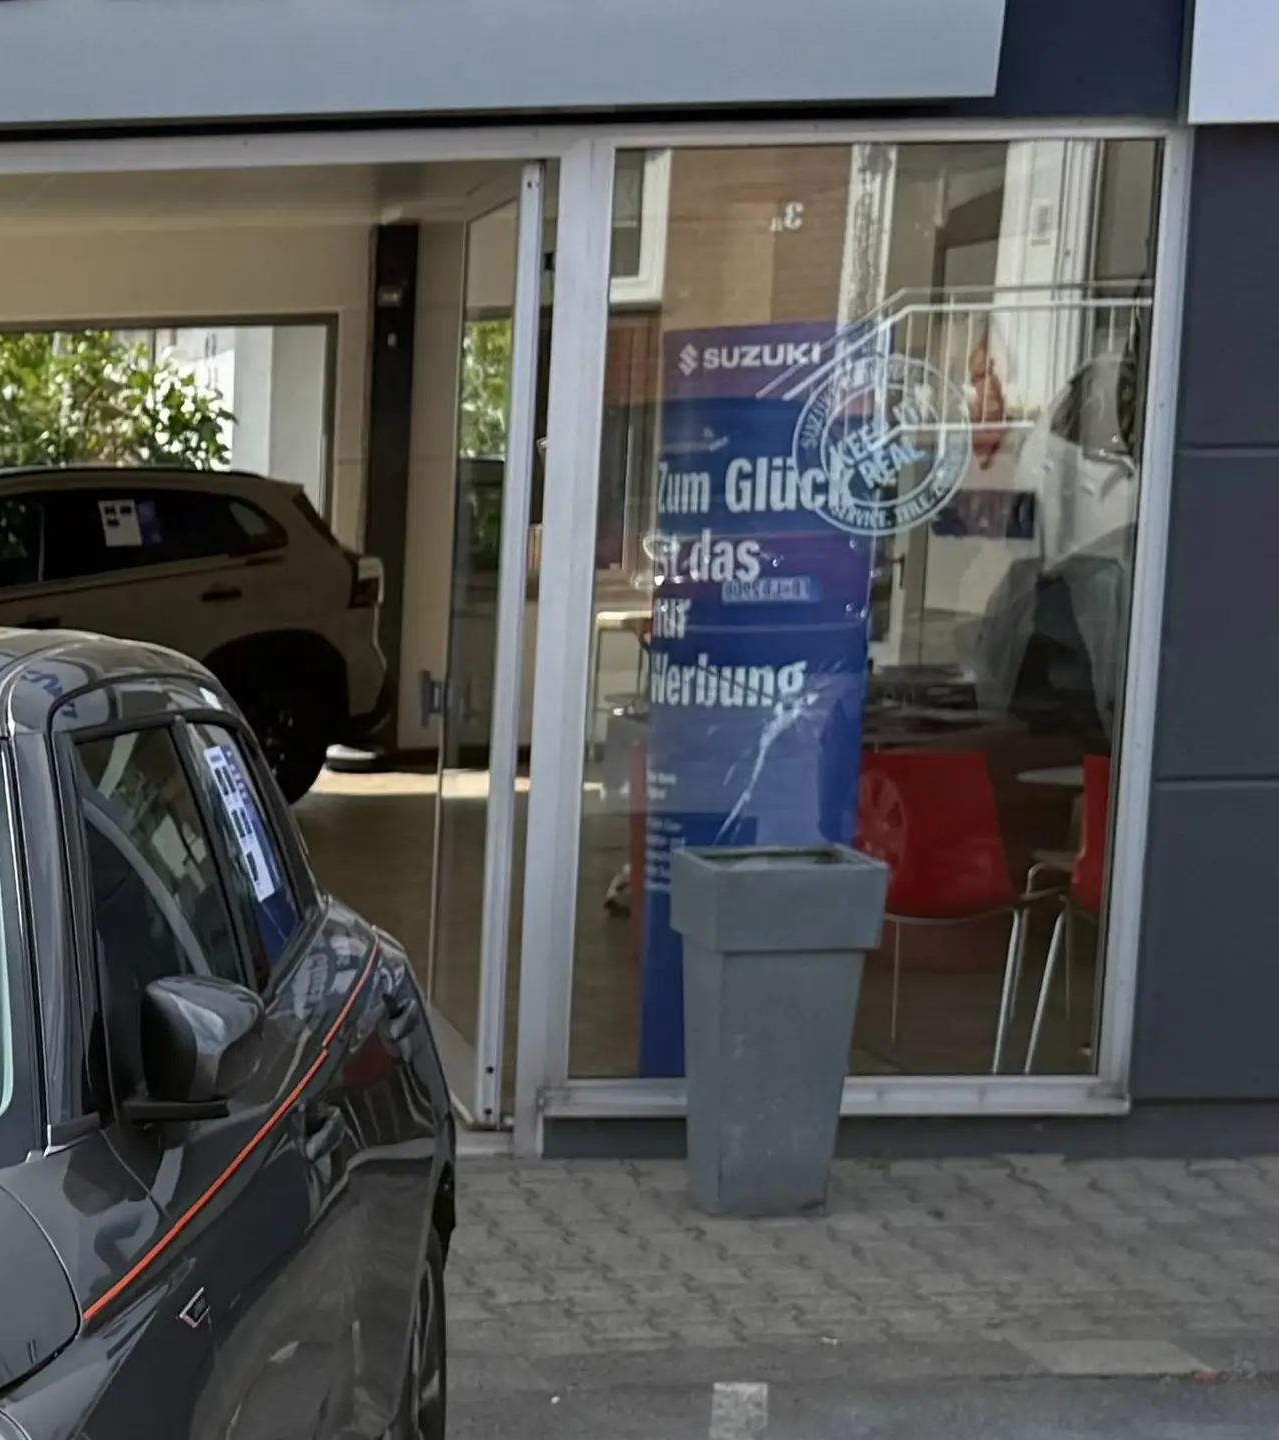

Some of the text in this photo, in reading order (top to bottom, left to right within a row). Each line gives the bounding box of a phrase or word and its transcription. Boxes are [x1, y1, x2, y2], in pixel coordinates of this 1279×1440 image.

[703, 342, 821, 369] SUZUKI
[657, 456, 855, 514] Zum Glück
[689, 528, 762, 583] das
